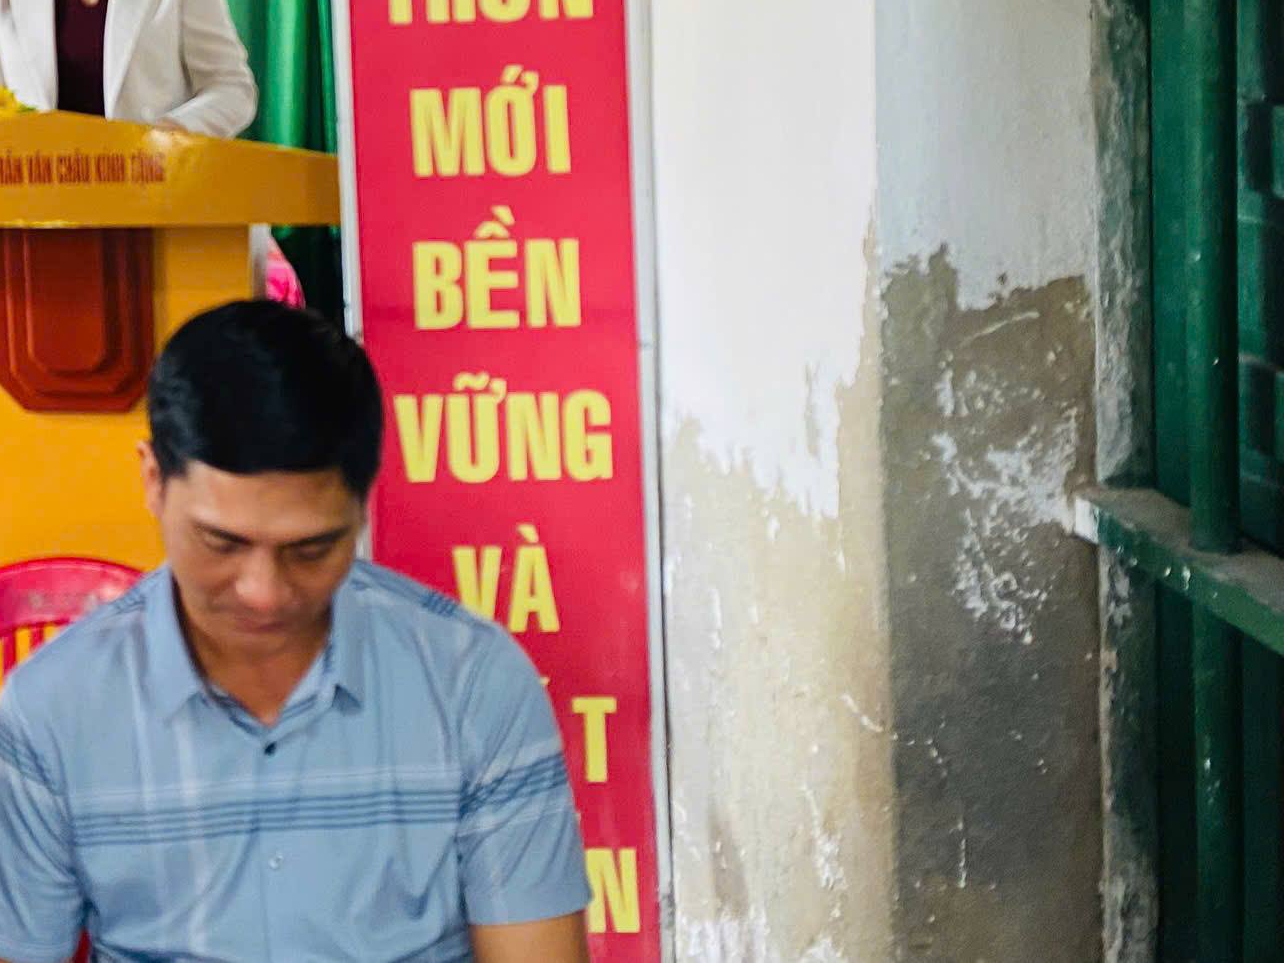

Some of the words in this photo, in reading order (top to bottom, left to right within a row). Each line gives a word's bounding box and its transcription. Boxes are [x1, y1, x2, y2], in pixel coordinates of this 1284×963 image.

[410, 64, 572, 176] MỚI
[412, 204, 581, 330] BỀN
[393, 371, 613, 483] VỮNG
[452, 524, 560, 633] VÀ
